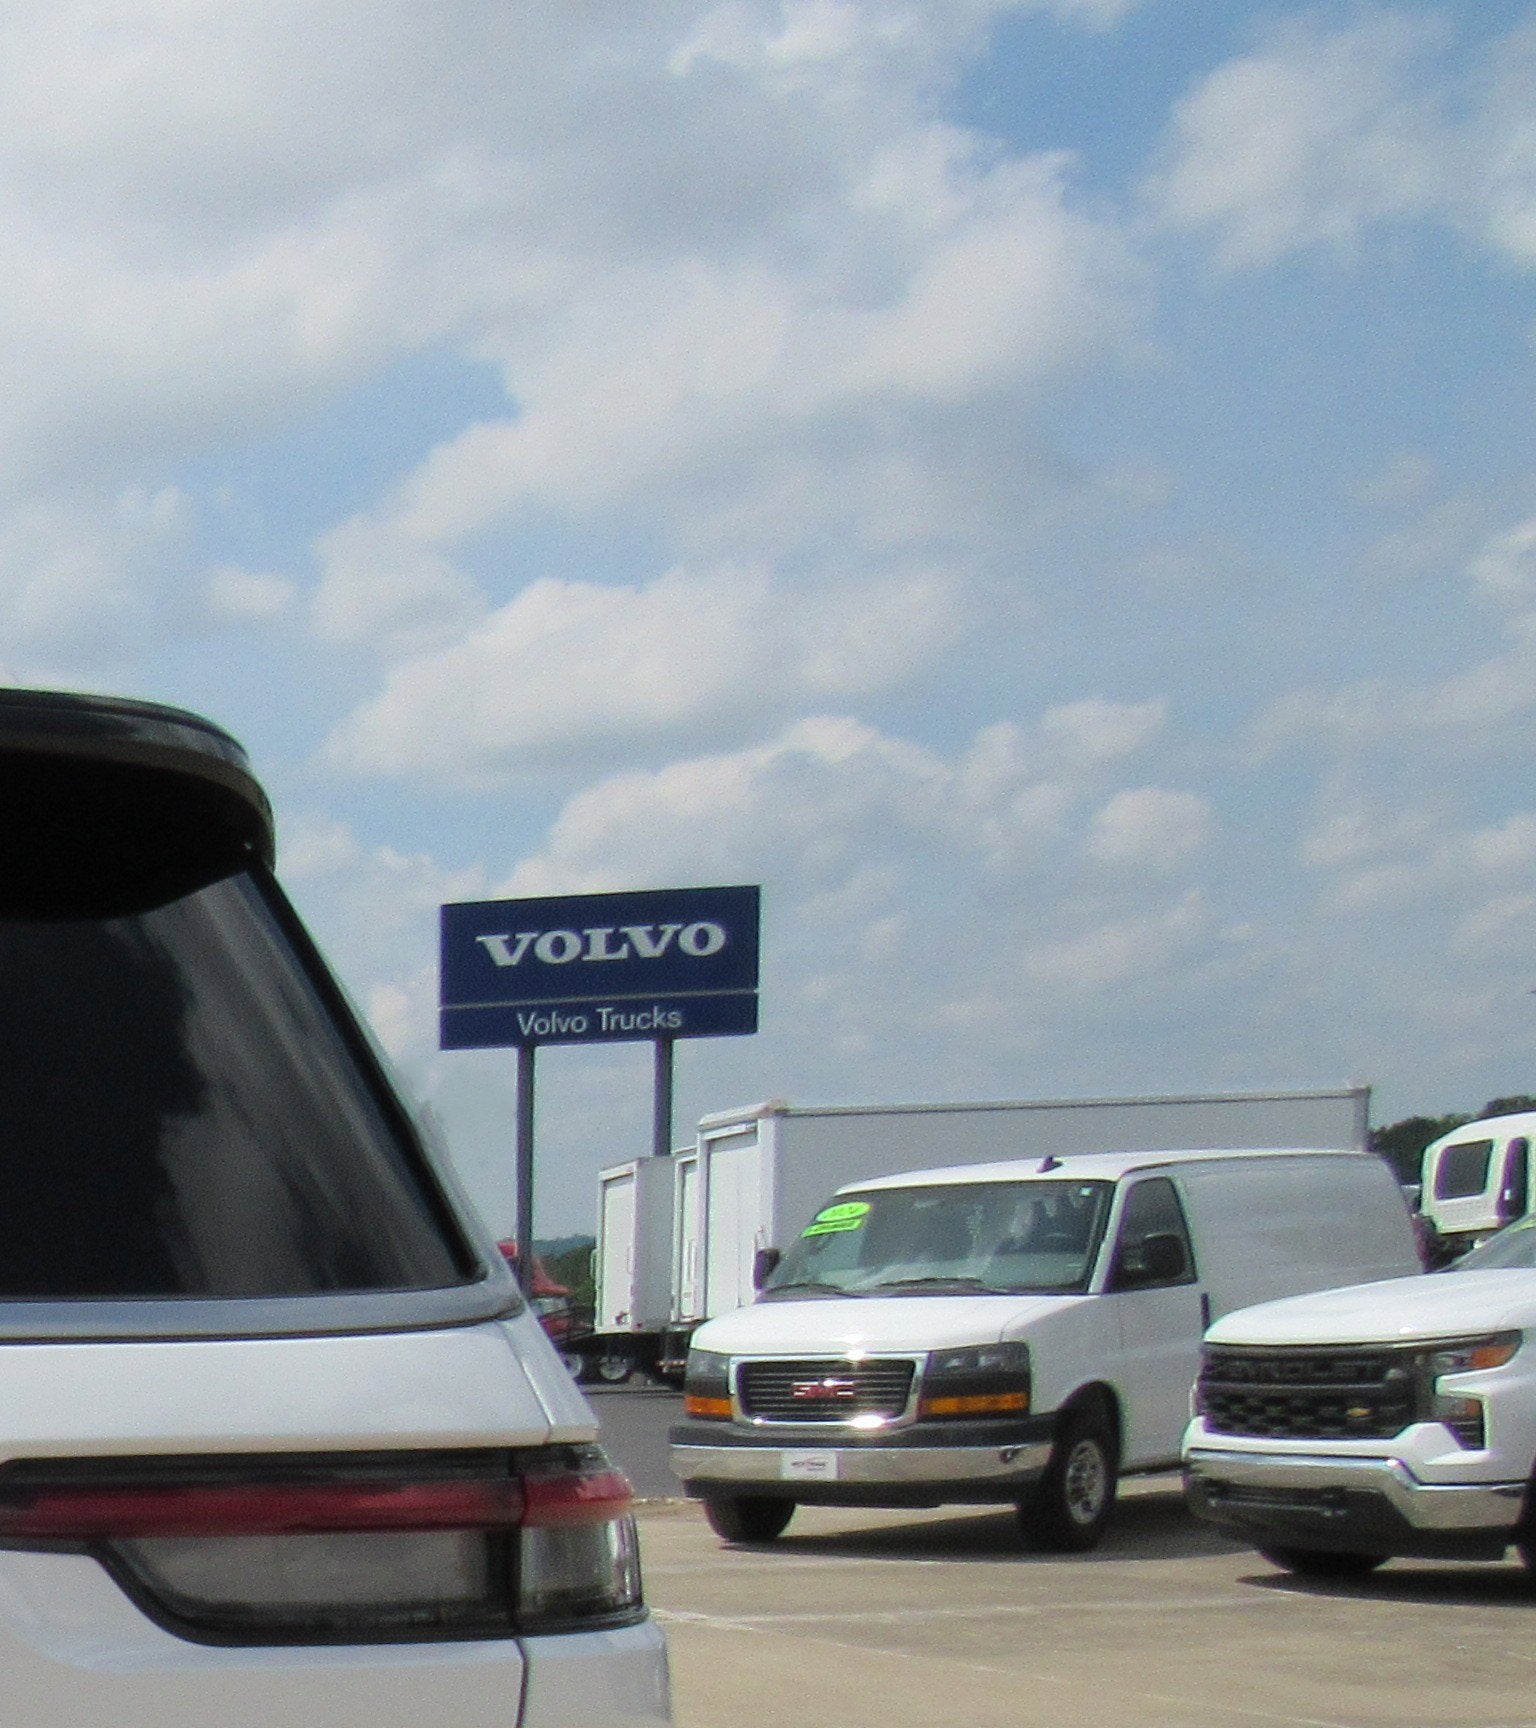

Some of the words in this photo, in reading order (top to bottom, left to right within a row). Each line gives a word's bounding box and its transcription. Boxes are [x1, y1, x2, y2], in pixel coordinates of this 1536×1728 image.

[474, 920, 727, 967] VOLVO
[517, 1010, 588, 1037] Volvo
[595, 1005, 683, 1032] Trucks
